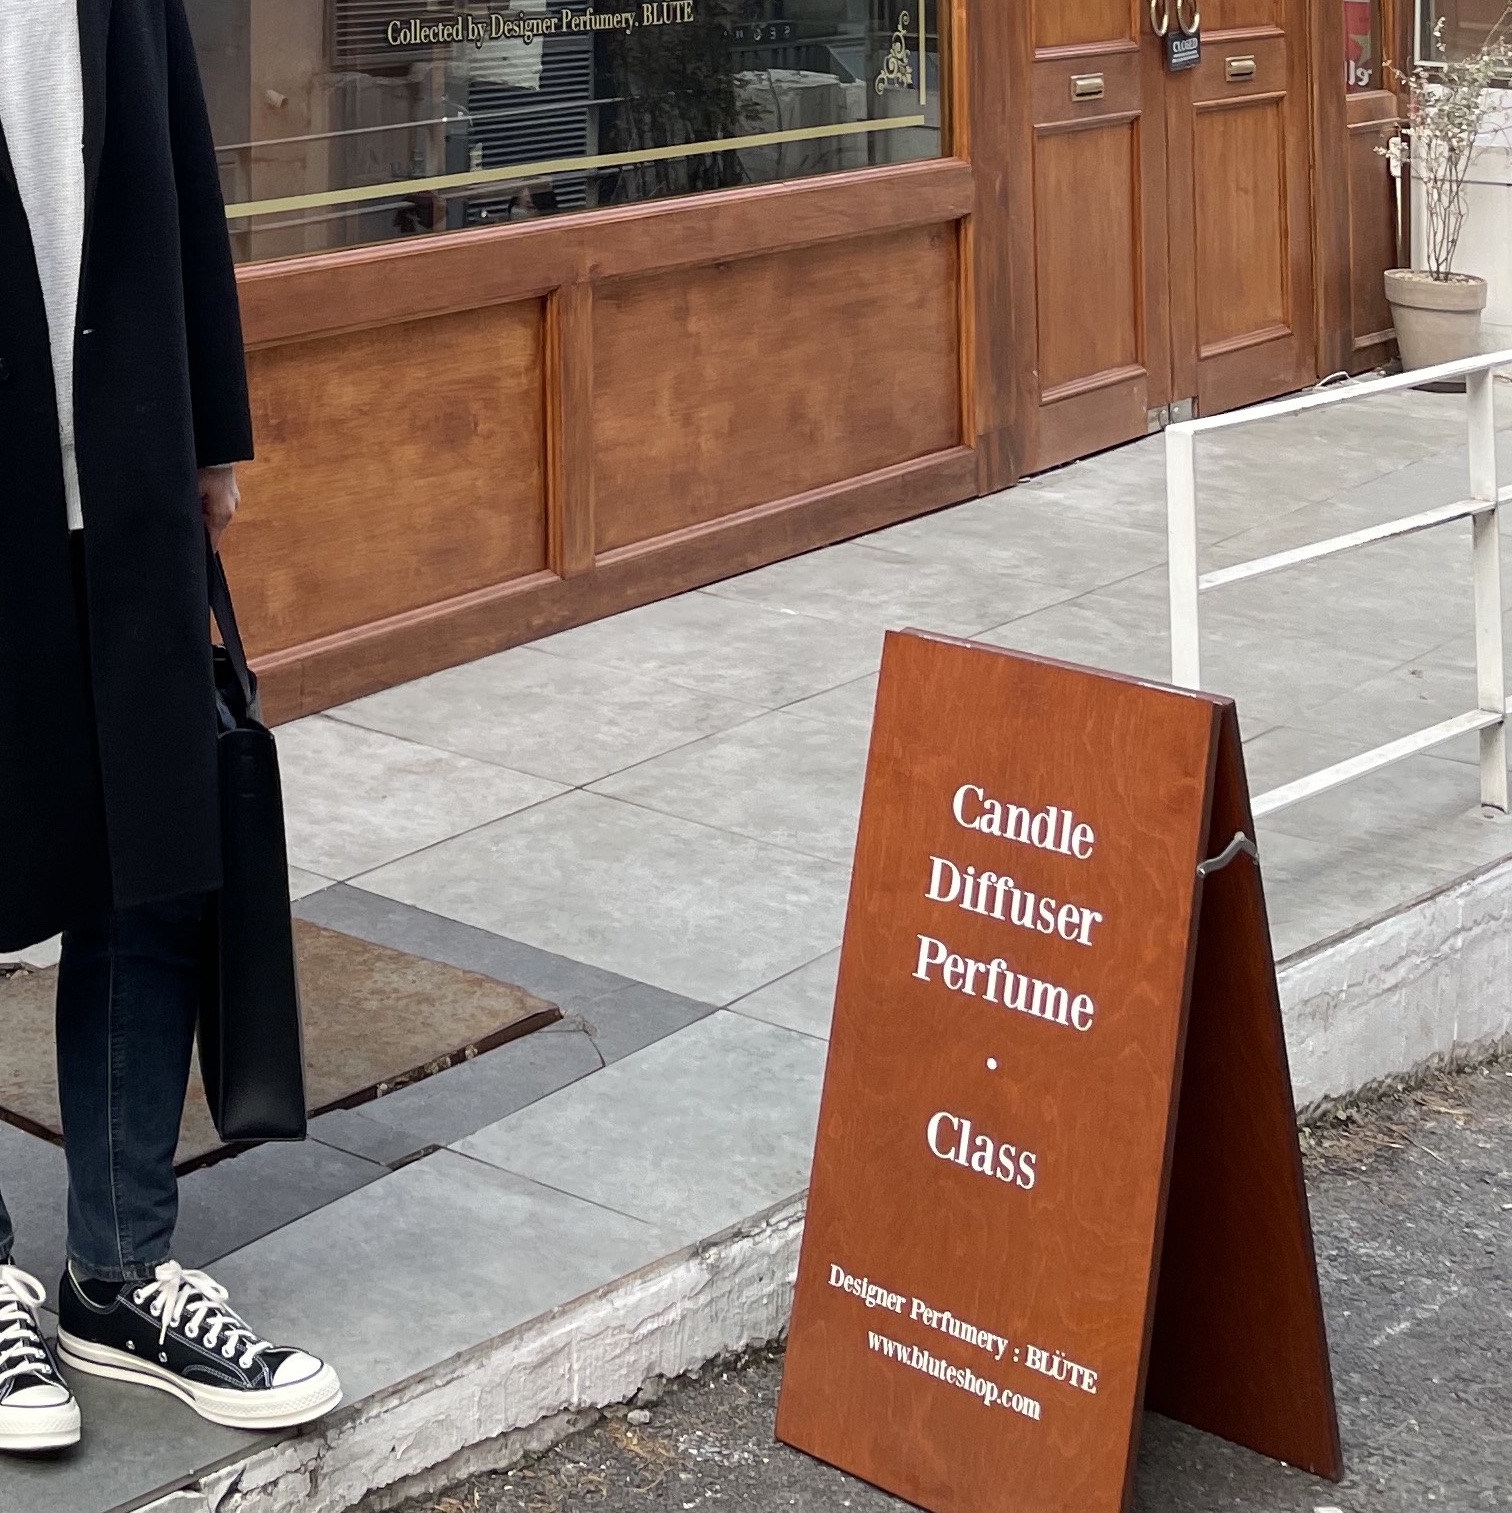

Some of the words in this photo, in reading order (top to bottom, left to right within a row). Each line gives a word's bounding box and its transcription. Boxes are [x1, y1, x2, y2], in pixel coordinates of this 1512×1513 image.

[387, 17, 463, 47] Collected
[467, 18, 487, 49] by
[490, 10, 558, 42] Designer
[562, 9, 640, 36] Perfumery.
[952, 784, 1095, 860] Candle
[925, 856, 1102, 947] Diffuser
[912, 935, 1095, 1032] Perfume
[927, 1111, 1037, 1191] Class
[828, 1264, 906, 1317] Designer
[910, 1298, 1009, 1361] Perfumery
[1025, 1341, 1098, 1394] BLÜTE
[867, 1329, 1041, 1420] www.bluteshop.com
